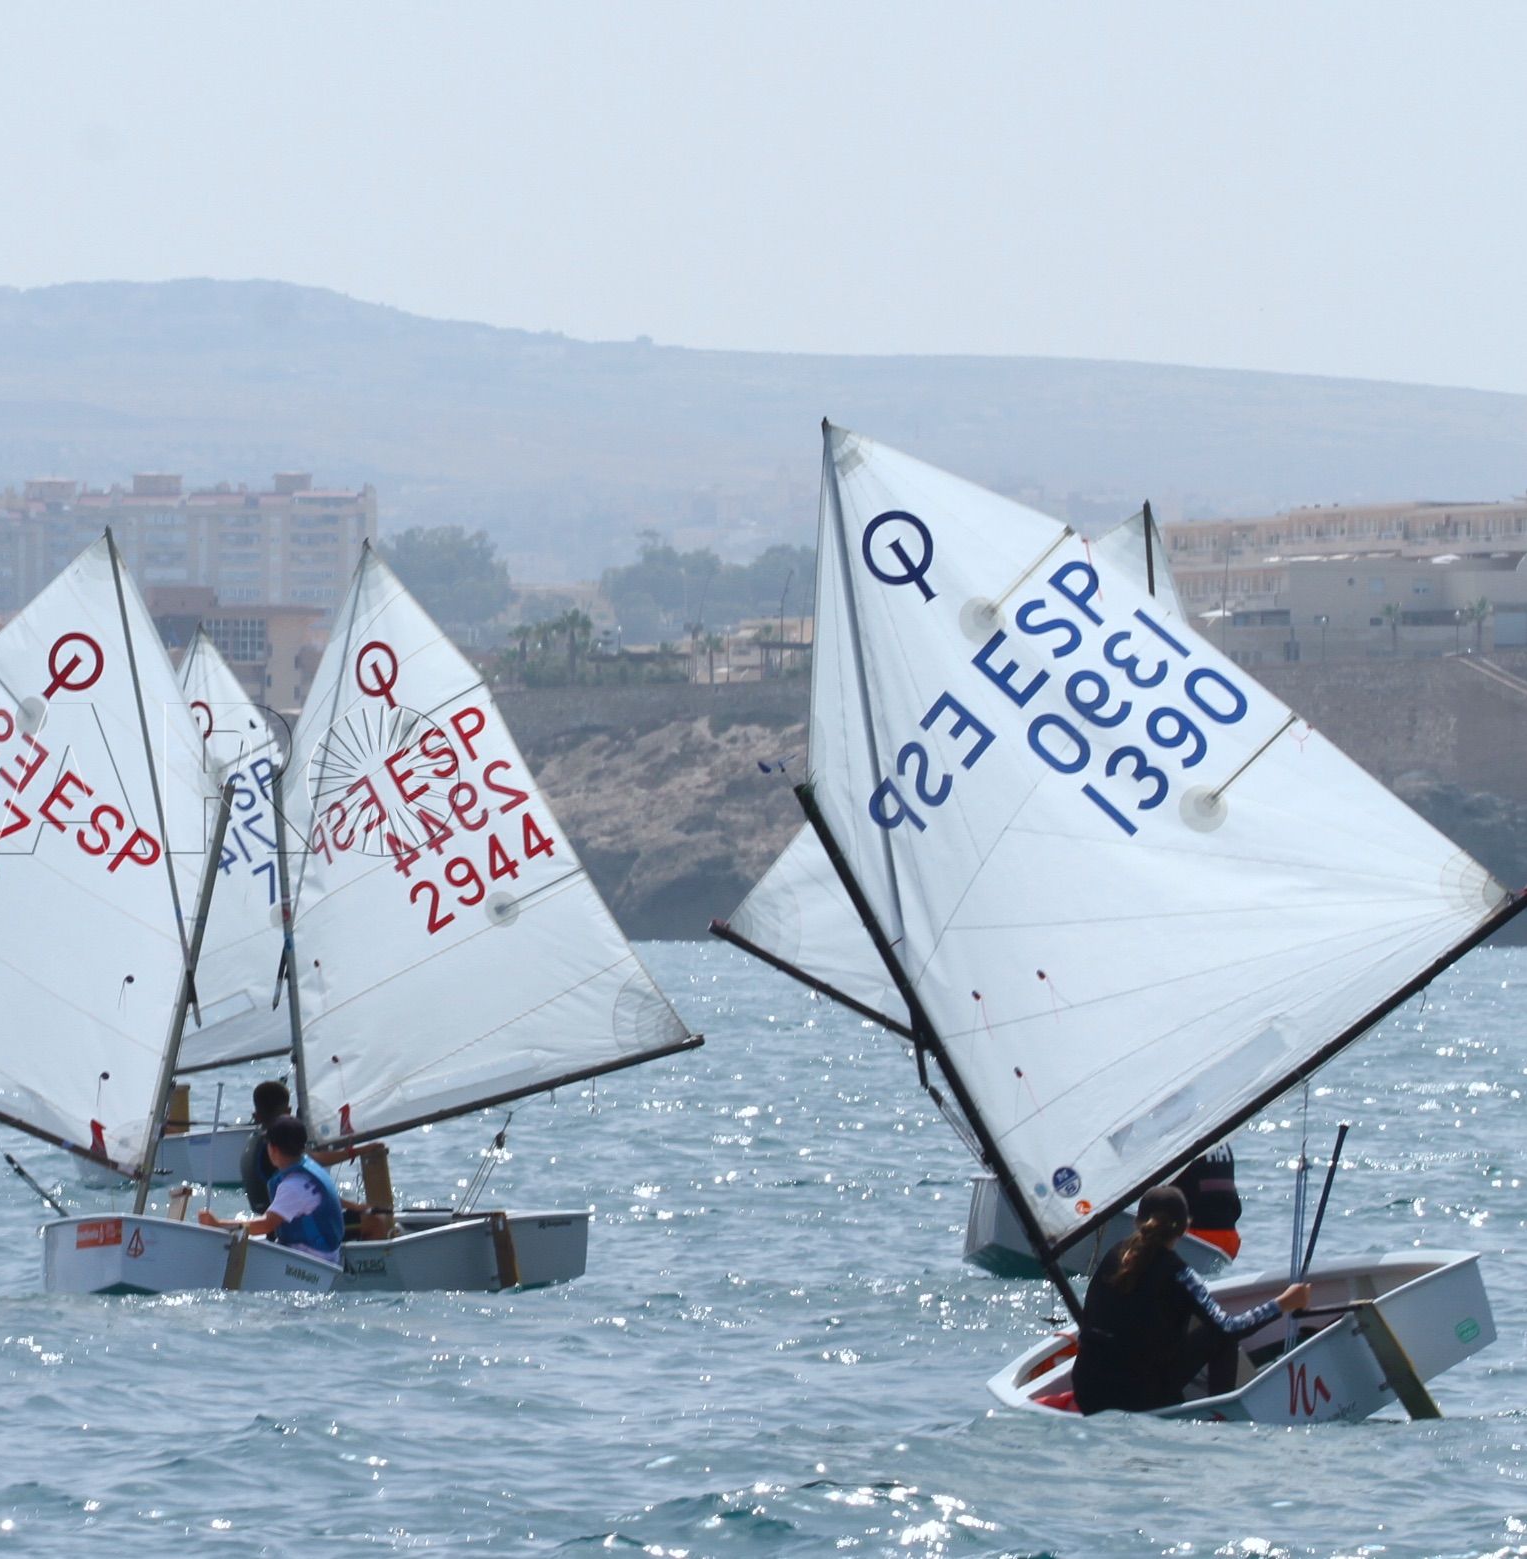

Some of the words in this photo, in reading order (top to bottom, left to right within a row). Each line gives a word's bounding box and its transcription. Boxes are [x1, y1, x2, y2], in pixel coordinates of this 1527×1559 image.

[972, 560, 1104, 709] ESP
[226, 756, 275, 812] SP
[384, 706, 487, 804] ESP
[1081, 667, 1248, 837] 1390
[38, 771, 162, 873] ESP
[409, 814, 555, 934] 2944
